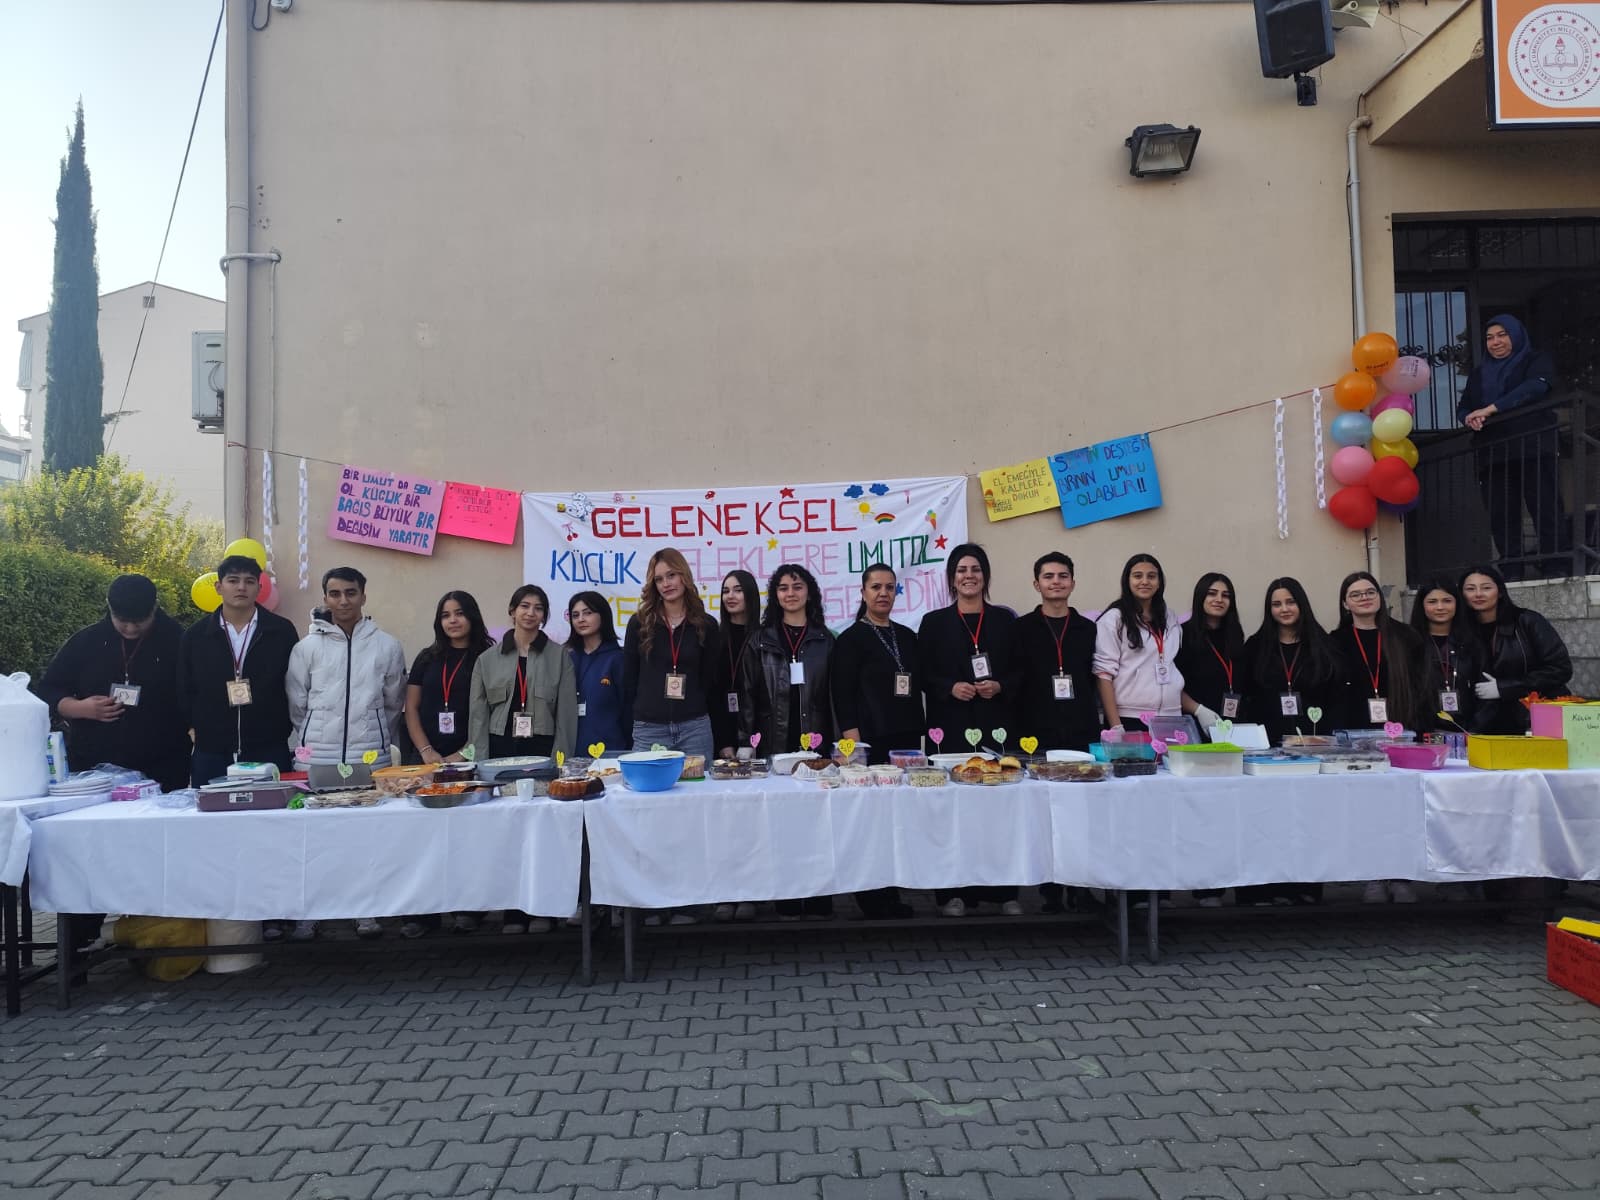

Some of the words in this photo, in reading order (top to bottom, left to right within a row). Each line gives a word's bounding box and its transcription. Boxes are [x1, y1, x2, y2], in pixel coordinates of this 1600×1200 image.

[362, 474, 394, 487] UMUT
[341, 483, 355, 496] OL
[404, 494, 420, 507] BİR
[1013, 490, 1039, 501] DOKUN
[416, 512, 434, 529] BİR
[389, 529, 429, 548] YARATIR
[550, 549, 641, 586] KÜÇÜK
